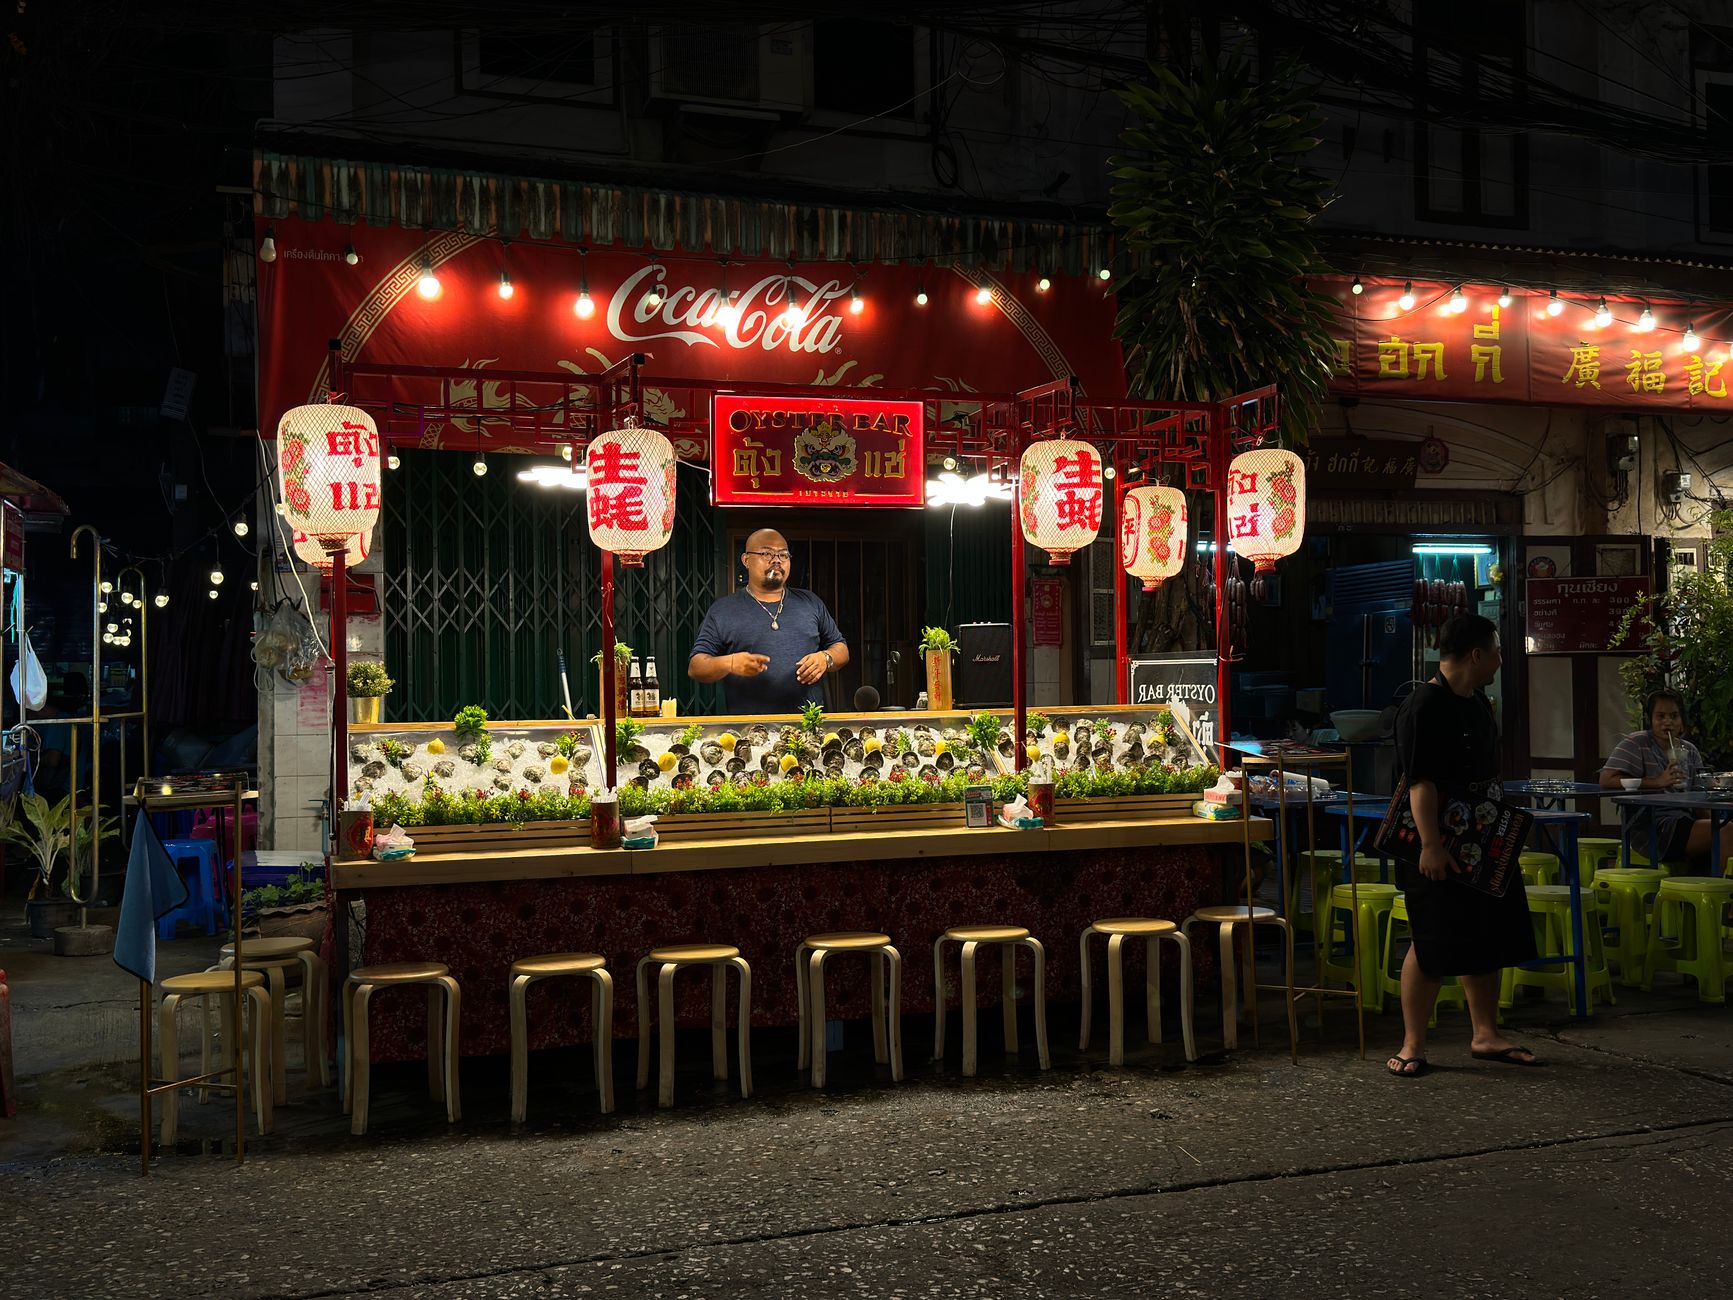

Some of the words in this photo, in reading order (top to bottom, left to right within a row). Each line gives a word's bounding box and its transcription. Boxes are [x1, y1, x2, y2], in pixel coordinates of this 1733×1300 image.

[606, 264, 855, 354] Coca-Cola
[1561, 341, 1728, 398] 廣福記
[729, 409, 848, 432] OYSTER
[853, 411, 914, 437] BAR
[733, 436, 783, 489] ตุ้ง
[864, 438, 907, 479] แช่
